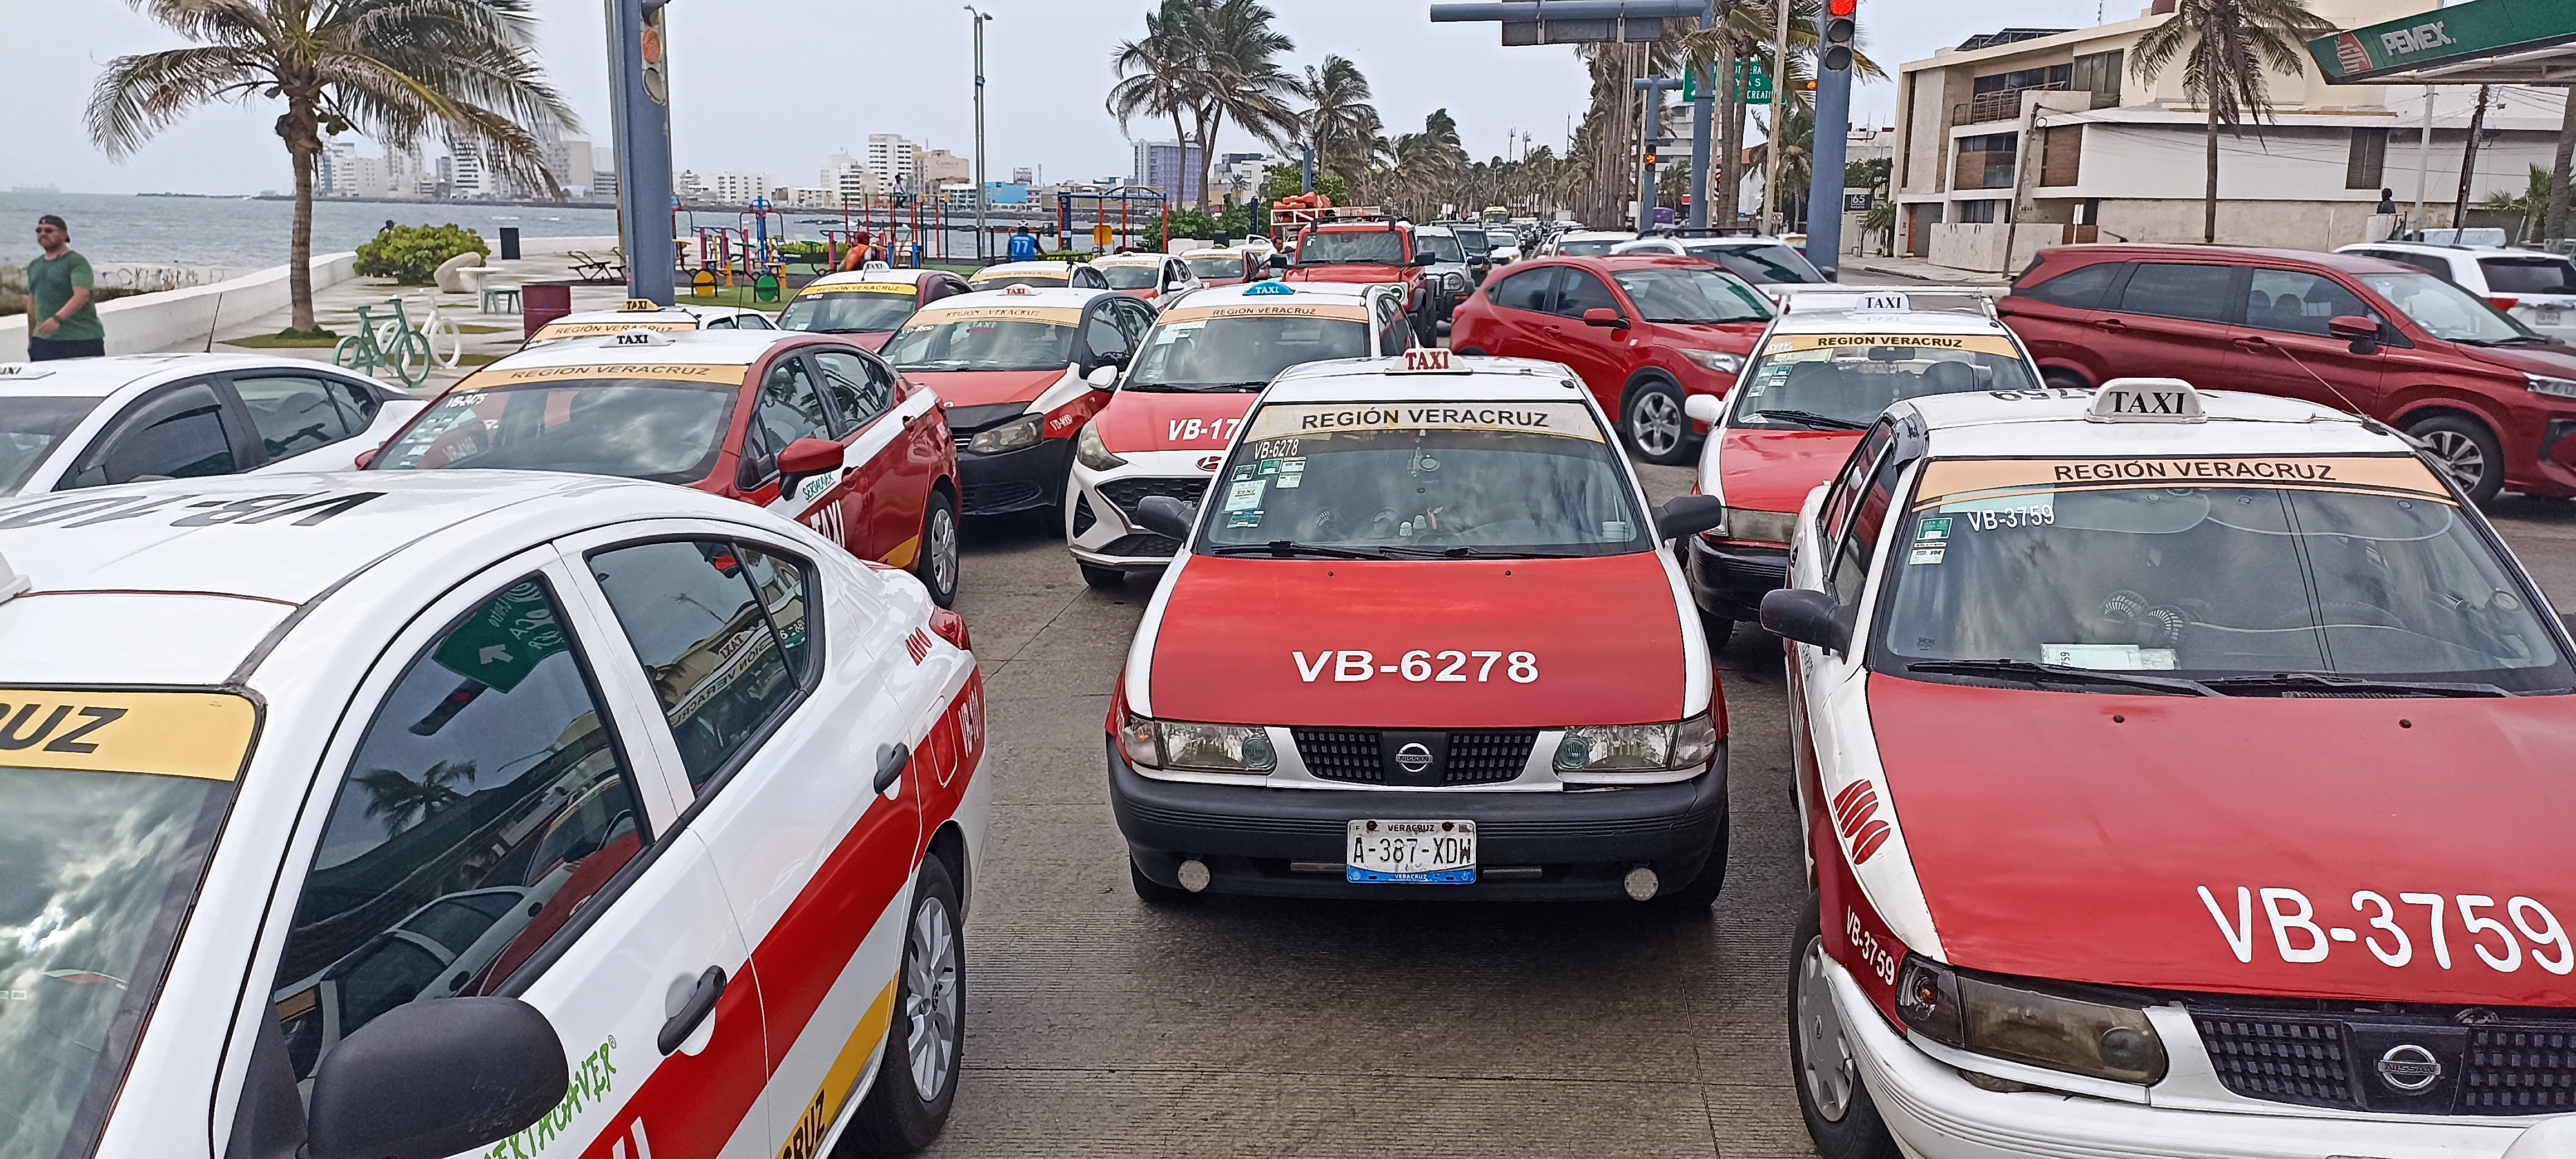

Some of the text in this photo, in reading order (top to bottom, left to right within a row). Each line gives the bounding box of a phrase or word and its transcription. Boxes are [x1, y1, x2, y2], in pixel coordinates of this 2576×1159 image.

[2380, 21, 2451, 56] PEMEX
[1014, 240, 1028, 254] 77
[626, 300, 648, 310] TAXI
[1865, 297, 1901, 309] TAXI
[617, 335, 648, 344] TAXI
[1881, 337, 1962, 348] VERACRUZ
[597, 366, 711, 376] VERACRUZ
[1405, 352, 1450, 371] TAXI
[2109, 392, 2185, 414] TAXI
[1302, 406, 1549, 430] REGIÓN VERACRUZ
[1169, 418, 1241, 441] VB-17
[1255, 439, 1299, 460] VB-6278
[2055, 459, 2337, 482] REGIÓN VERACRUZ
[810, 499, 845, 548] TAXI
[1967, 504, 2055, 532] VB-3759
[1291, 650, 1540, 684] VB-6278
[2060, 651, 2071, 666] 759
[1388, 824, 1435, 832] VERACRUZ
[1353, 837, 1471, 864] A-387-XDW
[2197, 884, 2575, 976] VB-3759
[1847, 905, 1895, 986] VB-3759
[2384, 1064, 2436, 1074] NISSAN
